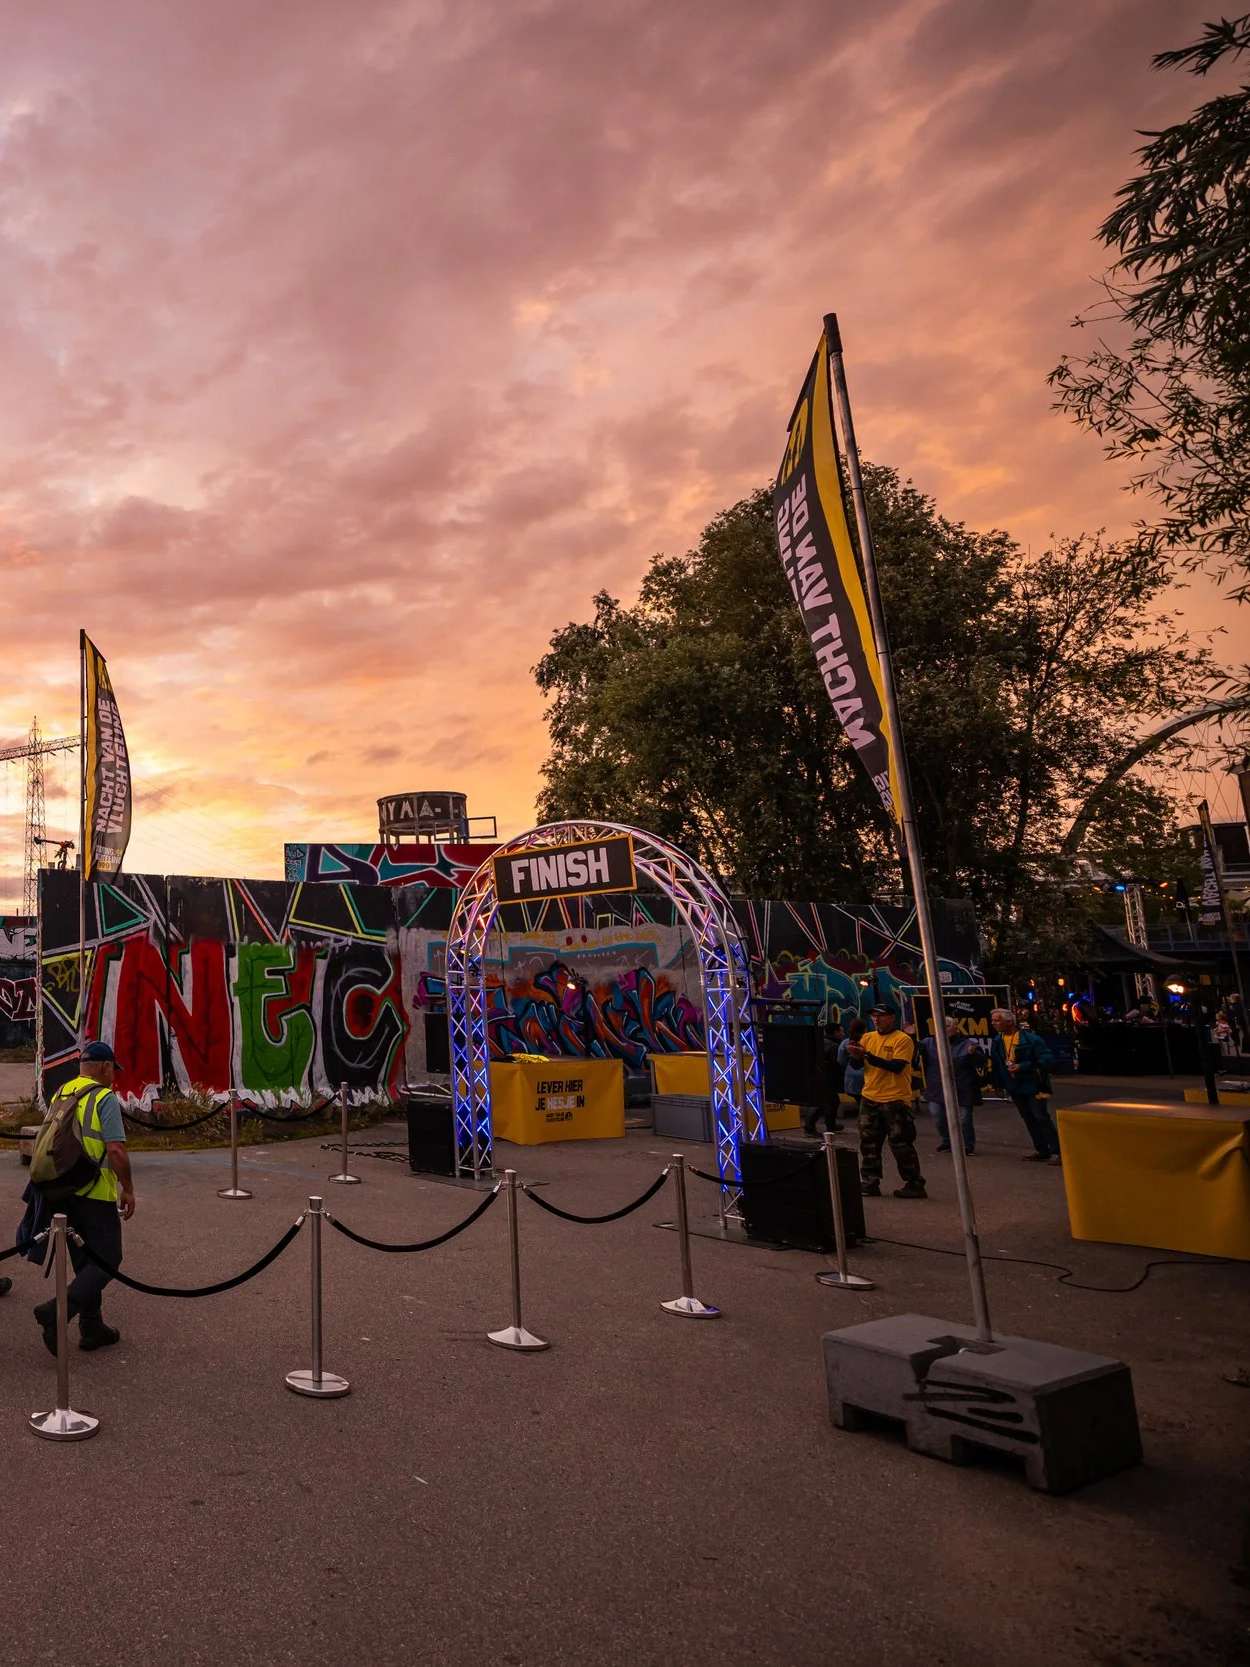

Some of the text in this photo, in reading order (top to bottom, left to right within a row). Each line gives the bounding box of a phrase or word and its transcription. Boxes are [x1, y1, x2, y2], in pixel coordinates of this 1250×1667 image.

[97, 697, 113, 724] DE
[100, 727, 115, 762] VAN
[95, 767, 115, 833] NACHT
[510, 847, 610, 894] FINISH
[536, 1079, 583, 1094] LEVER HIER
[535, 1095, 585, 1111] JE HESJE IN
